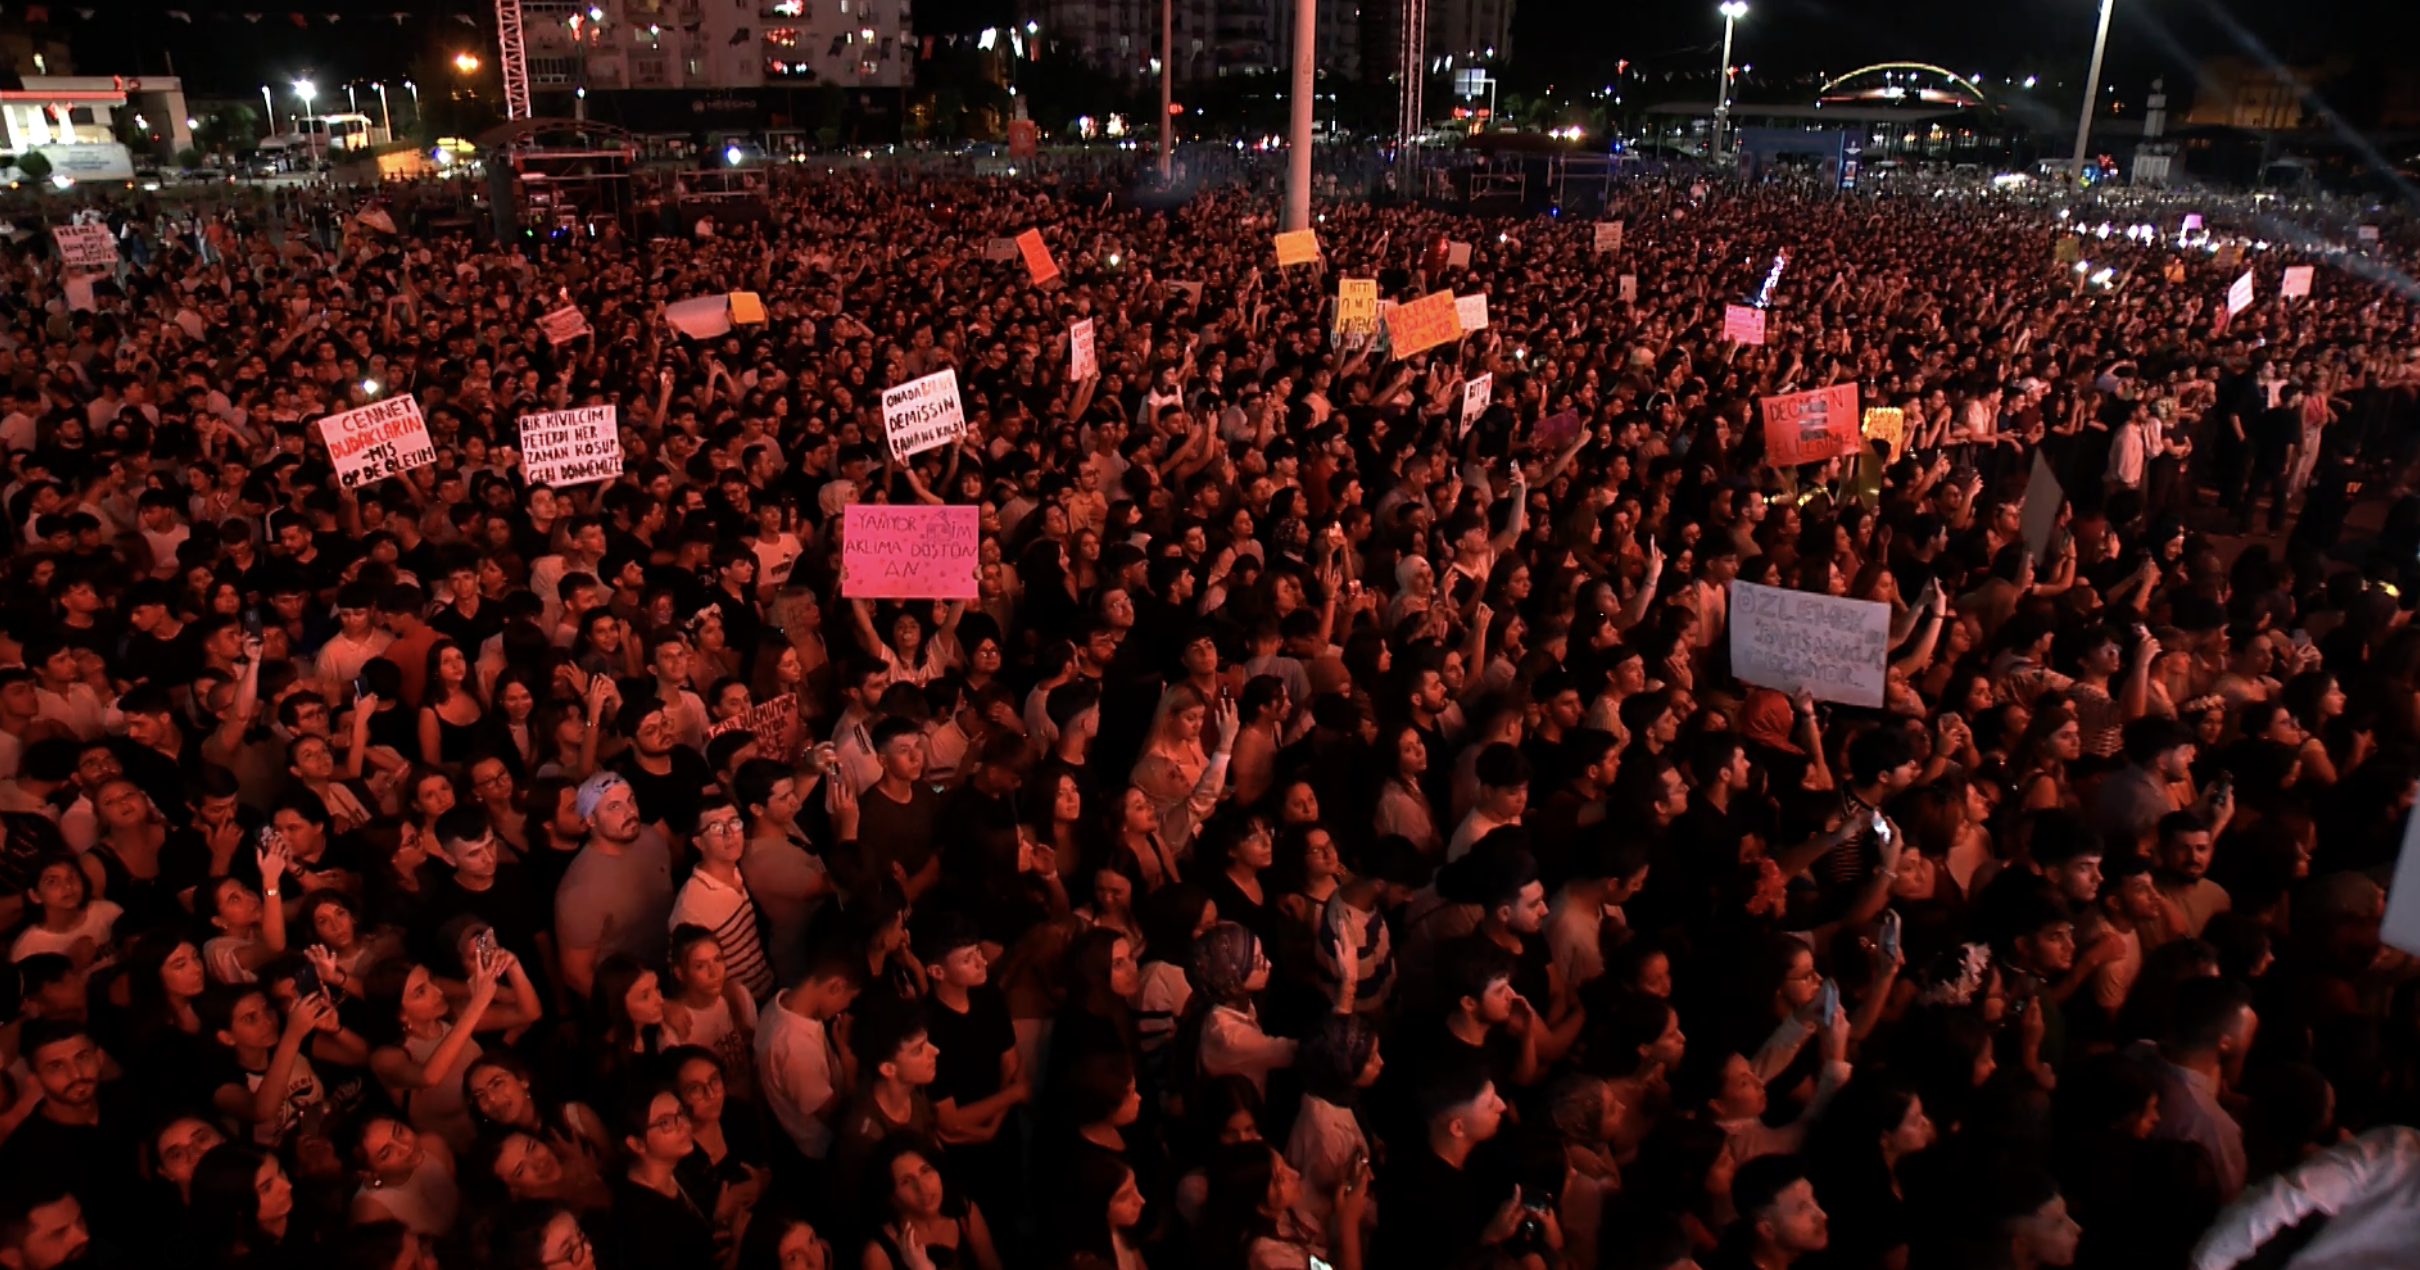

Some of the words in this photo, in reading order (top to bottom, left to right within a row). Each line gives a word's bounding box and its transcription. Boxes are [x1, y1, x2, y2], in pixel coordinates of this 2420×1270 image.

[342, 397, 412, 432] CENNET
[575, 425, 598, 441] HER
[526, 446, 570, 465] ZAMAN
[362, 462, 382, 480] DE
[884, 559, 920, 578] AN
